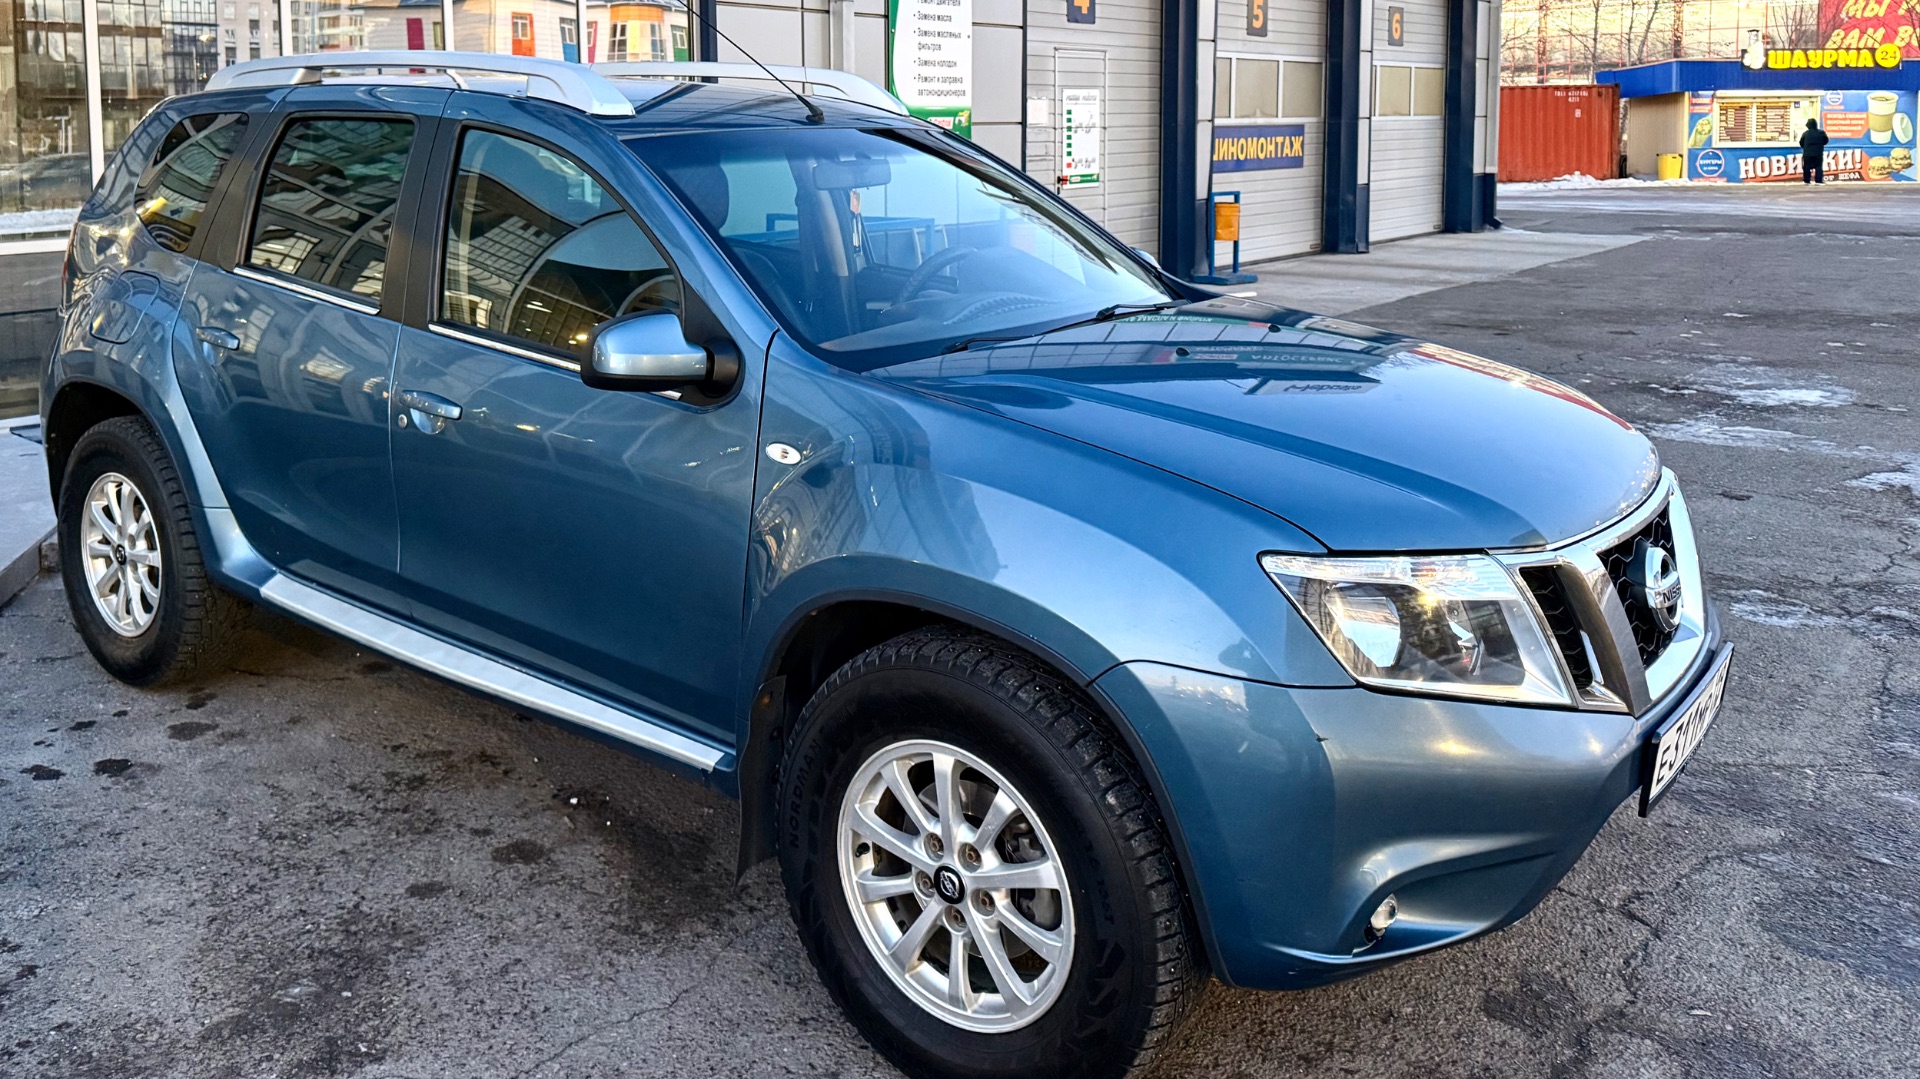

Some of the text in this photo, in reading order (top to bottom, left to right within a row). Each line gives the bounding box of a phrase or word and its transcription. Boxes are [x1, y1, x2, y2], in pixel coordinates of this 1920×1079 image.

[917, 10, 936, 21] Замена
[1252, 0, 1264, 29] 5
[917, 27, 936, 38] Замена
[1392, 13, 1401, 40] 6
[917, 57, 936, 67] Замена
[1767, 49, 1875, 69] ШАУРМА
[1738, 148, 1862, 179] НОВИКИ!
